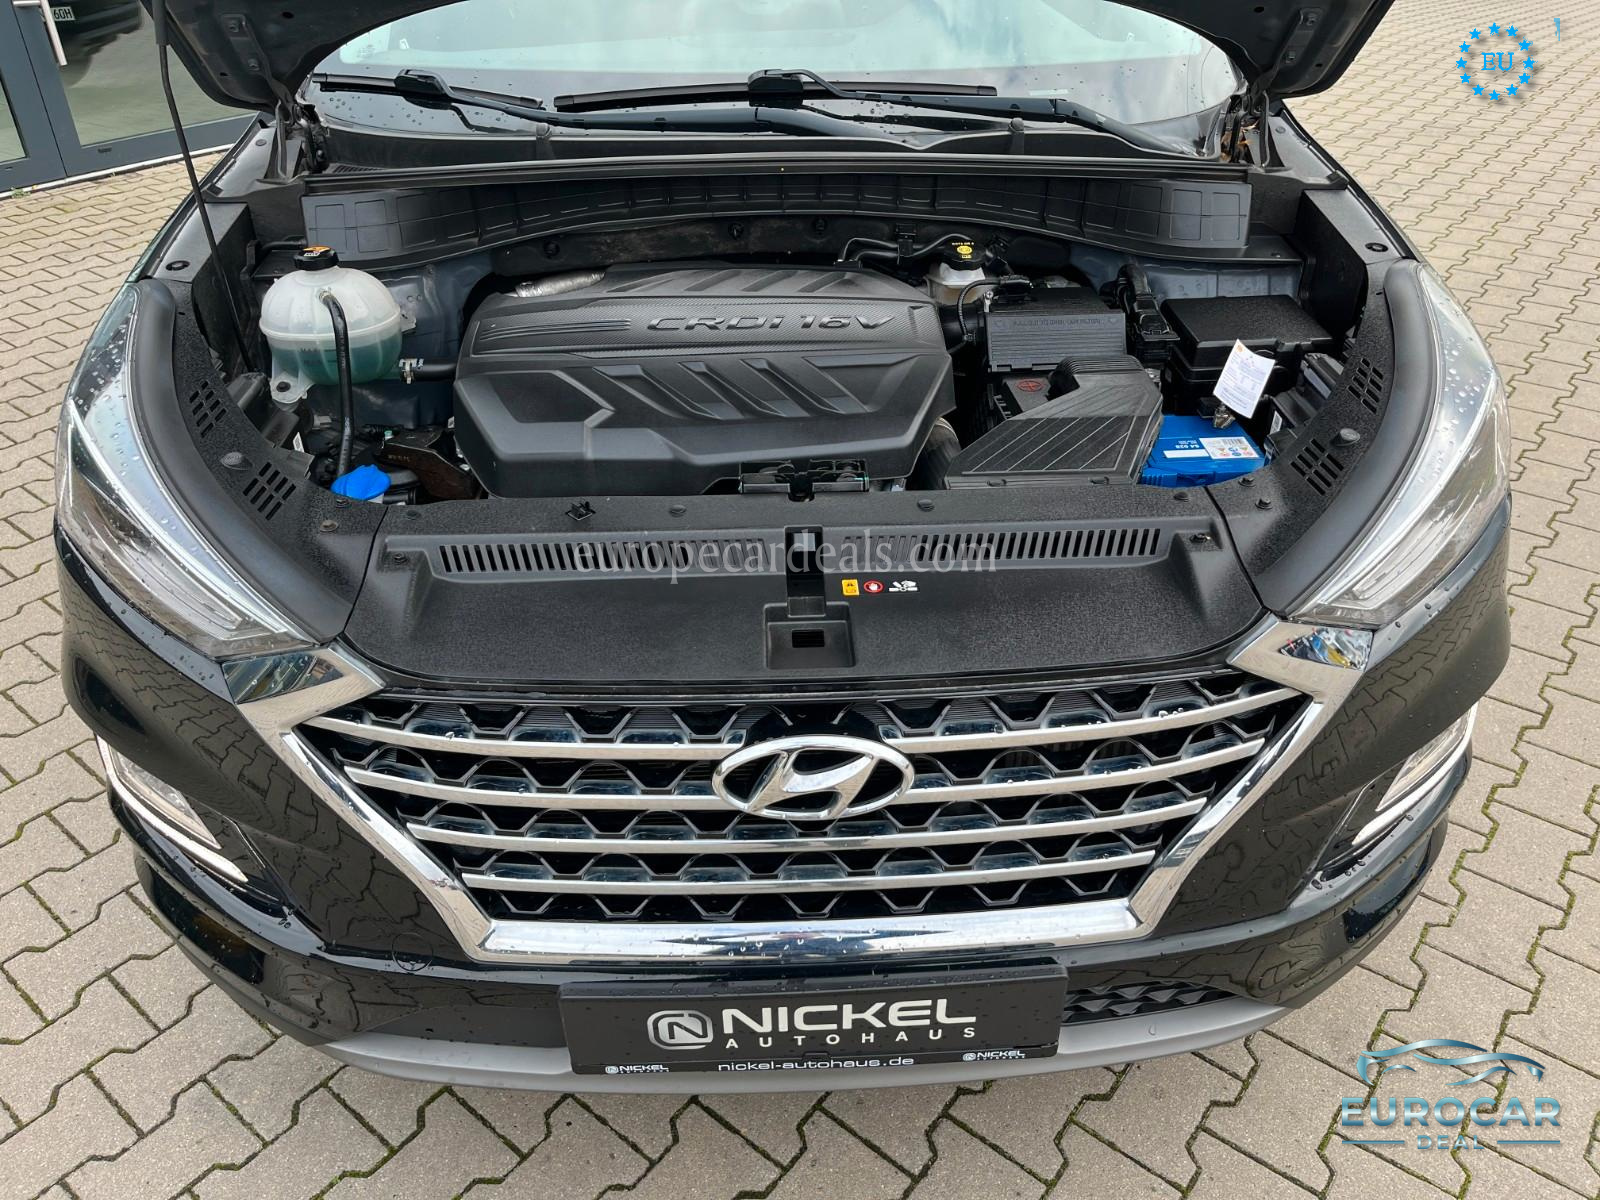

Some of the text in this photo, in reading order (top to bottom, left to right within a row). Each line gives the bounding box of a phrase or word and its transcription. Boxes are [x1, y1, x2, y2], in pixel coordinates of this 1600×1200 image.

[801, 315, 895, 330] 16V
[722, 998, 977, 1034] NICKEL
[725, 1027, 976, 1049] AUTOHAUS
[977, 1050, 1027, 1058] NICKEL
[619, 1064, 670, 1072] NICKEL
[718, 1056, 915, 1072] nickel-autohaus.de
